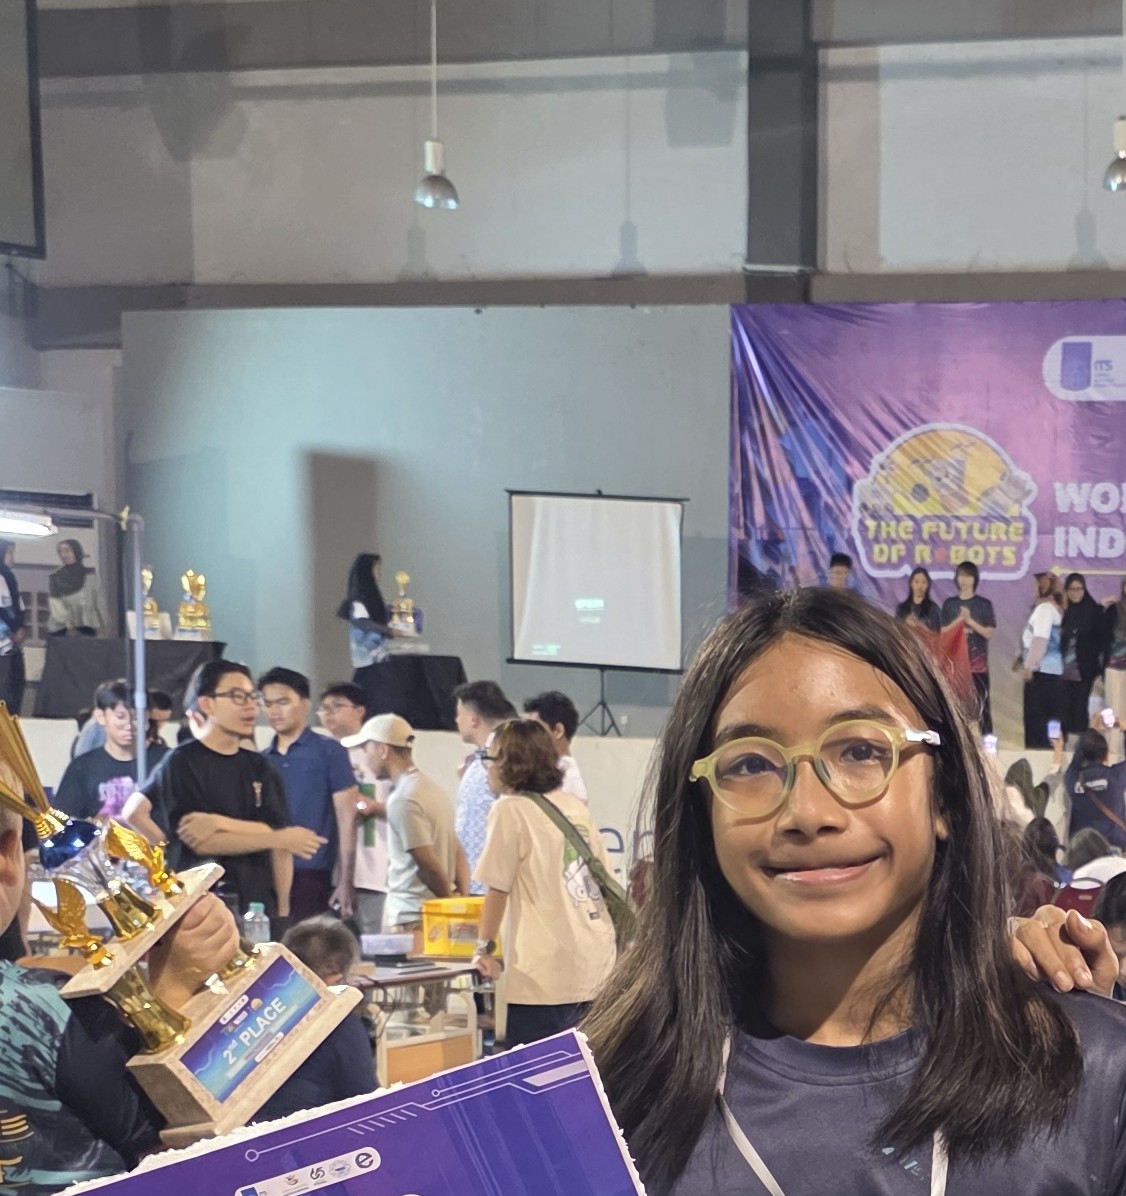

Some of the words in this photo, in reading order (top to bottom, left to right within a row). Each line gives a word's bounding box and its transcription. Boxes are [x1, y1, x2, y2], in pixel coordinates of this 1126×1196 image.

[866, 520, 913, 540] THE
[922, 521, 1024, 542] FUTURE
[873, 544, 906, 564] OF
[239, 997, 287, 1047] PLACE
